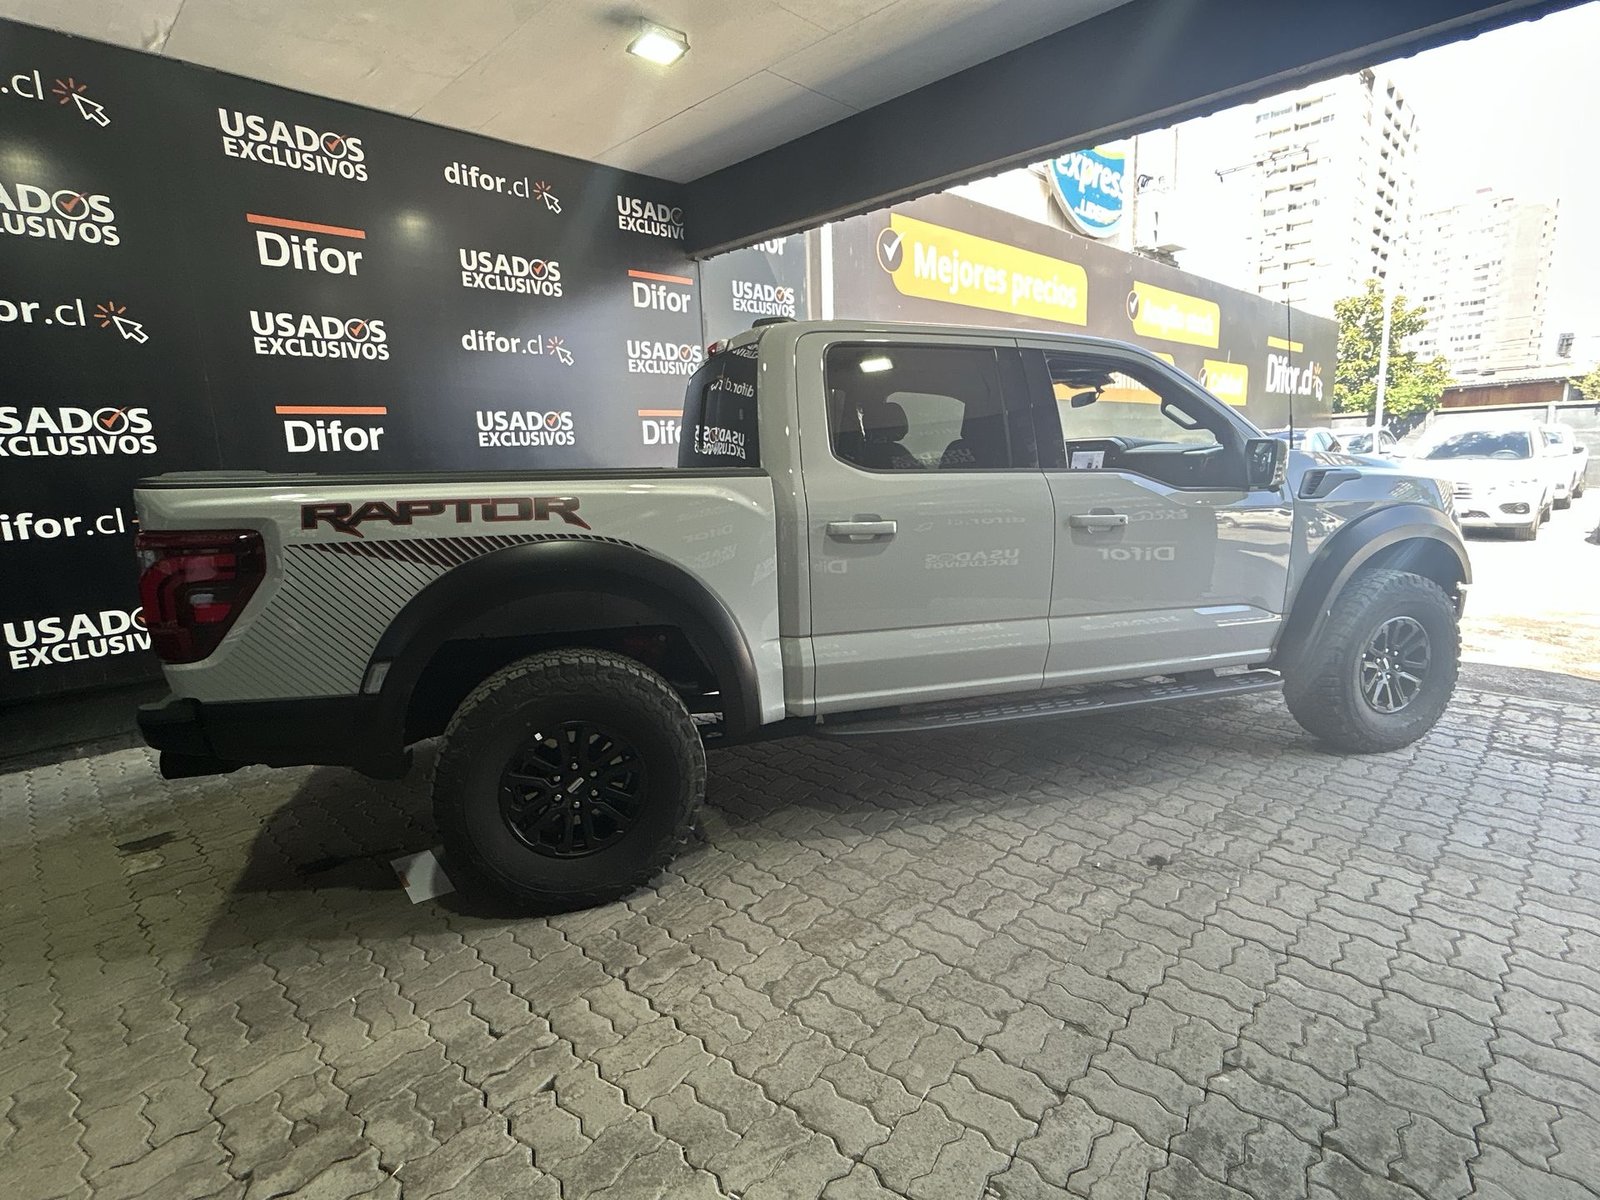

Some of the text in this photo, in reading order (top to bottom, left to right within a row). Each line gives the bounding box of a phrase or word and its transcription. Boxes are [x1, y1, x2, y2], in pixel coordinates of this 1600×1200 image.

[218, 107, 366, 163] USADOS
[222, 136, 369, 182] EXCLUSIVOS
[443, 162, 530, 199] difor.cl
[617, 195, 684, 226] USADO
[0, 212, 121, 246] USIVOS
[618, 215, 684, 240] EXCLUSIV
[255, 230, 363, 276] Difor
[459, 248, 561, 282] USADOS
[461, 270, 563, 298] EXCLUSIVOS
[913, 241, 1078, 308] Mejores precios
[632, 281, 691, 313] Difor
[732, 280, 795, 304] USADOS
[733, 298, 796, 318] EXCLUSIVOS
[250, 310, 387, 343] USADOS
[461, 329, 544, 355] difor.cl
[253, 336, 390, 361] EXCLUSIVOS
[627, 339, 703, 363] USADOS
[628, 358, 700, 376] EXCLUSIVO
[283, 419, 385, 453] Difor
[476, 410, 574, 432] USADOS
[642, 420, 682, 445] Dif
[478, 430, 575, 448] EXCLUSIVOS
[301, 495, 592, 539] RAPTOR
[2, 606, 149, 648] USAD
[9, 631, 152, 670] EXCLUSIV
